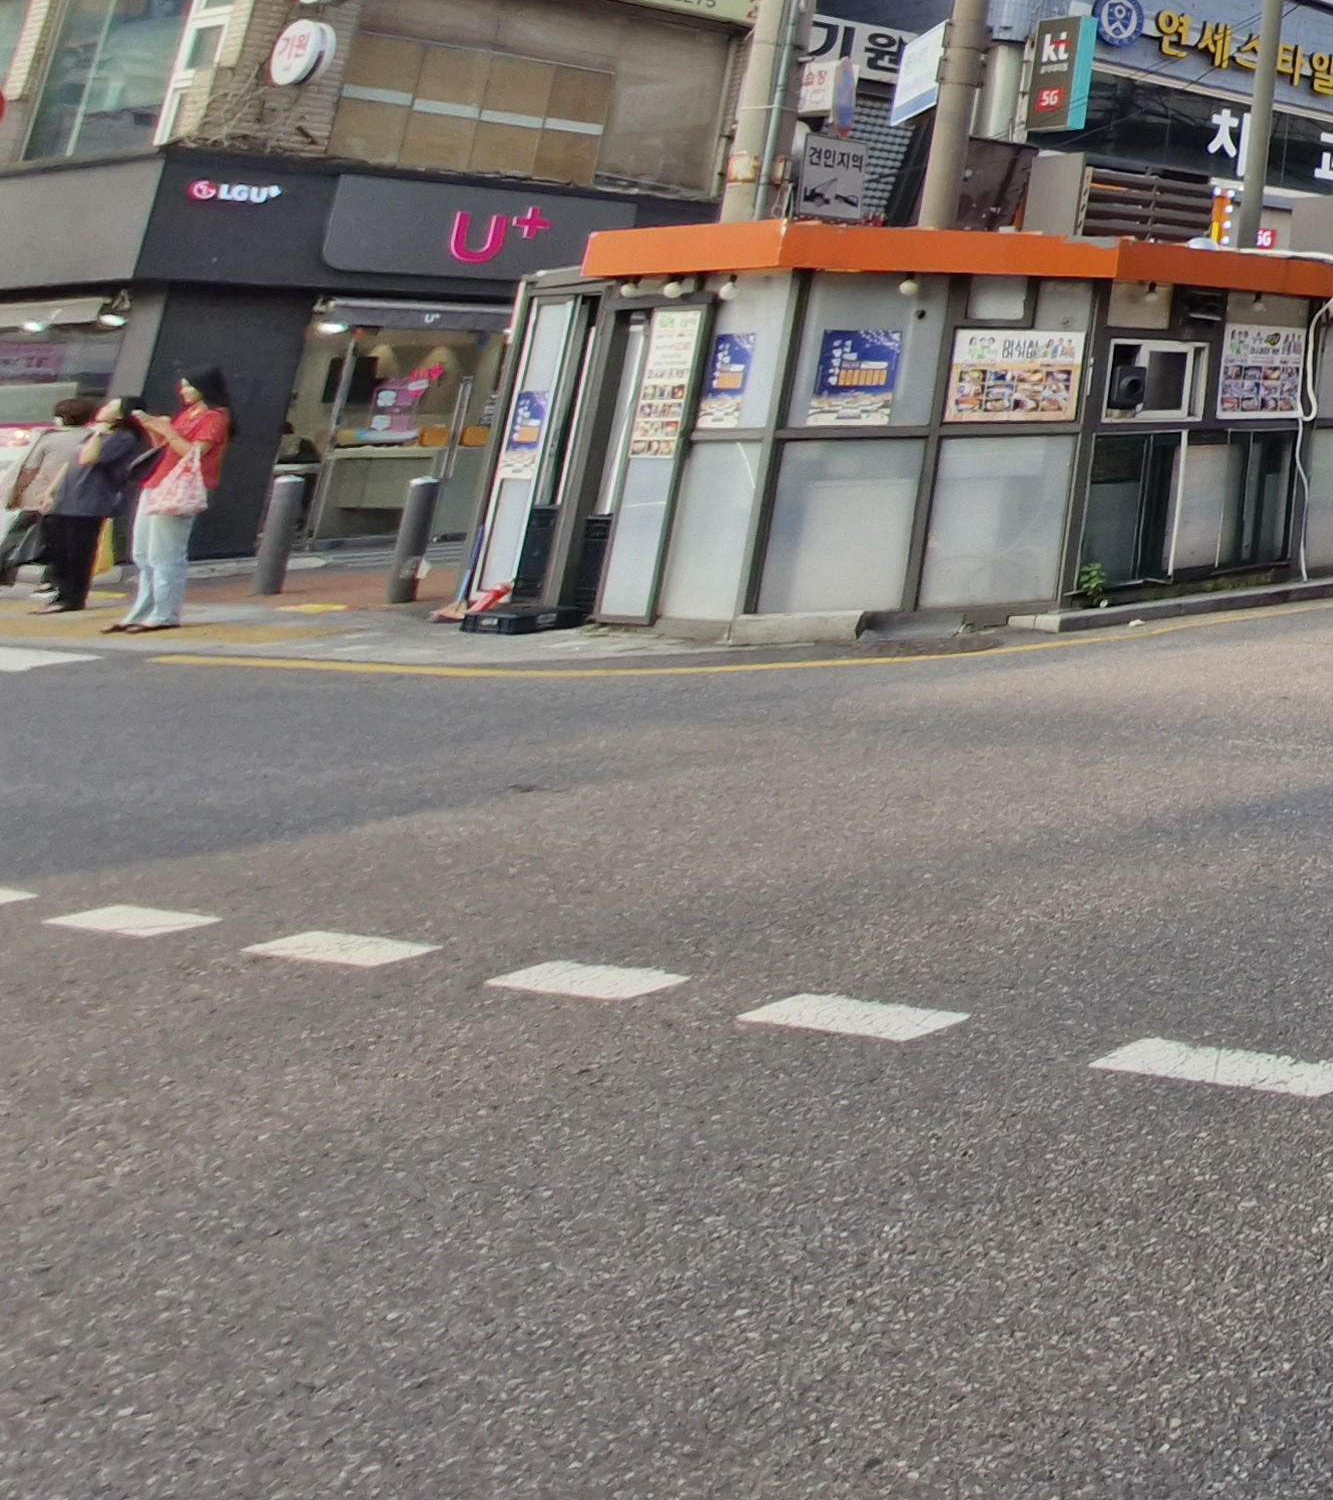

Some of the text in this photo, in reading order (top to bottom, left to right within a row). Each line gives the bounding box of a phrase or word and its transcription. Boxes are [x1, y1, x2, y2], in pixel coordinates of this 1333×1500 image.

[1042, 31, 1072, 62] kt
[1040, 88, 1060, 107] 5G
[808, 146, 865, 174] 견인지역
[449, 206, 553, 265] U+
